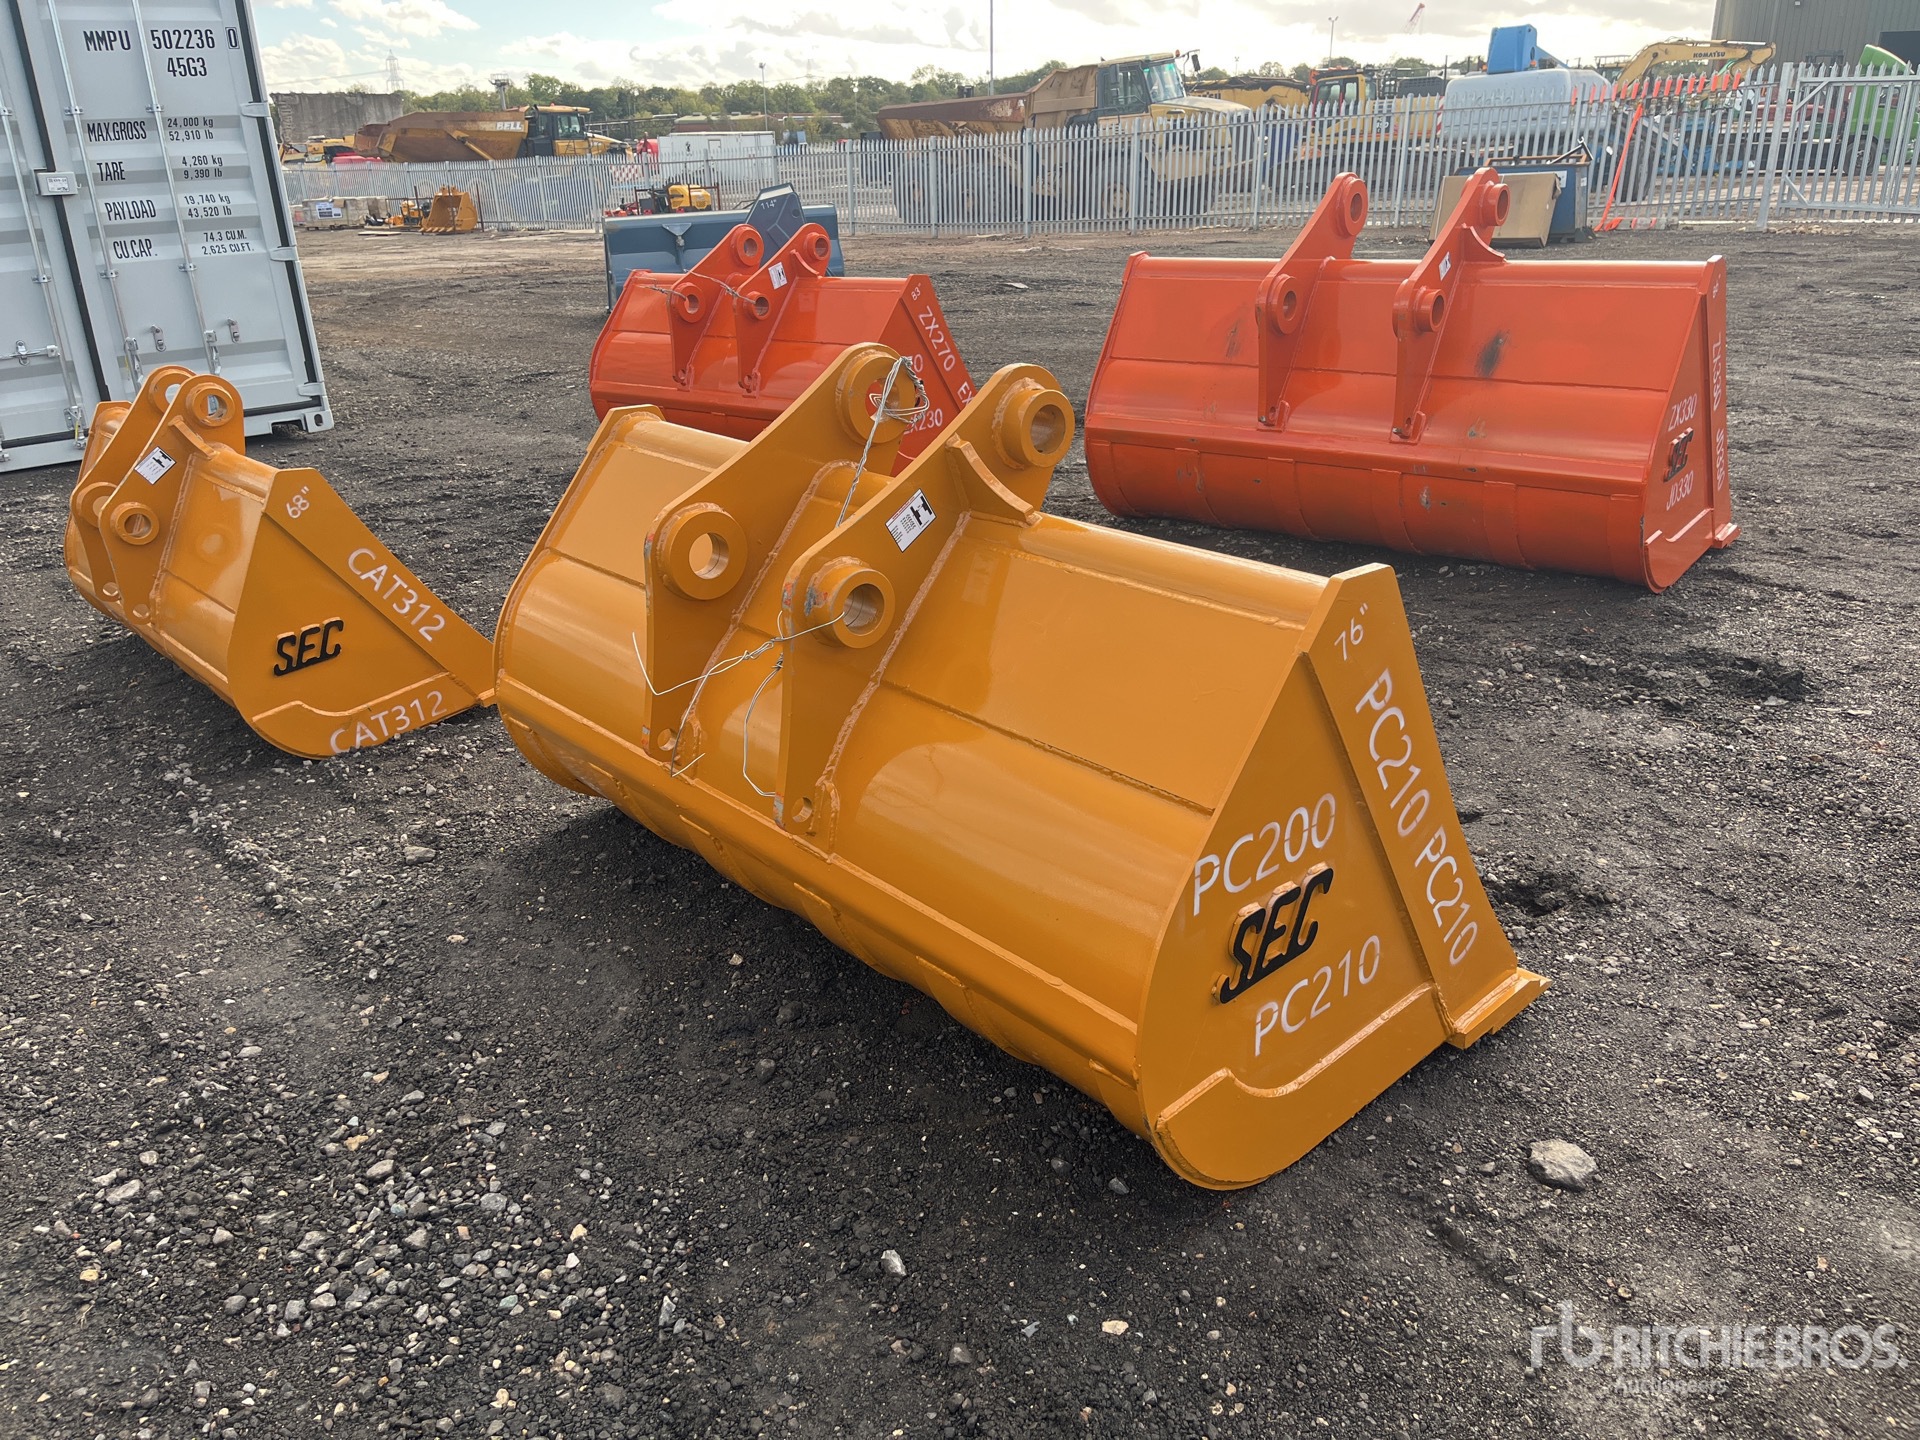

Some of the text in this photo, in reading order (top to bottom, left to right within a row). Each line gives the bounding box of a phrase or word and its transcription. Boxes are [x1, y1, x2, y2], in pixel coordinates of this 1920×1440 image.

[83, 28, 238, 51] MMPU 502236 0
[167, 57, 207, 77] 45G3
[167, 117, 214, 128] 24,000 kg
[496, 121, 522, 130] BELL
[169, 129, 214, 142] 52,910 lb
[96, 161, 125, 181] TARE
[182, 155, 223, 168] 4,260 kg
[184, 168, 223, 180] 9,390 lb
[104, 199, 157, 221] PAYLOAD
[184, 193, 231, 206] 19,740 kg
[187, 205, 232, 219] 43,520 lb
[203, 232, 223, 243] 74.3
[201, 244, 228, 256] 2,625
[918, 305, 956, 372] ZX270
[1668, 393, 1697, 432] ZX330
[1666, 470, 1694, 511] JD330
[347, 547, 447, 643] CAT312
[1334, 602, 1370, 661] 76"
[273, 617, 344, 677] SEC
[329, 689, 448, 756] CAT312
[1355, 668, 1479, 966] PC210 PC210
[1192, 792, 1337, 917] PC200
[1218, 864, 1335, 1004] SEC
[1254, 934, 1382, 1057] PC210
